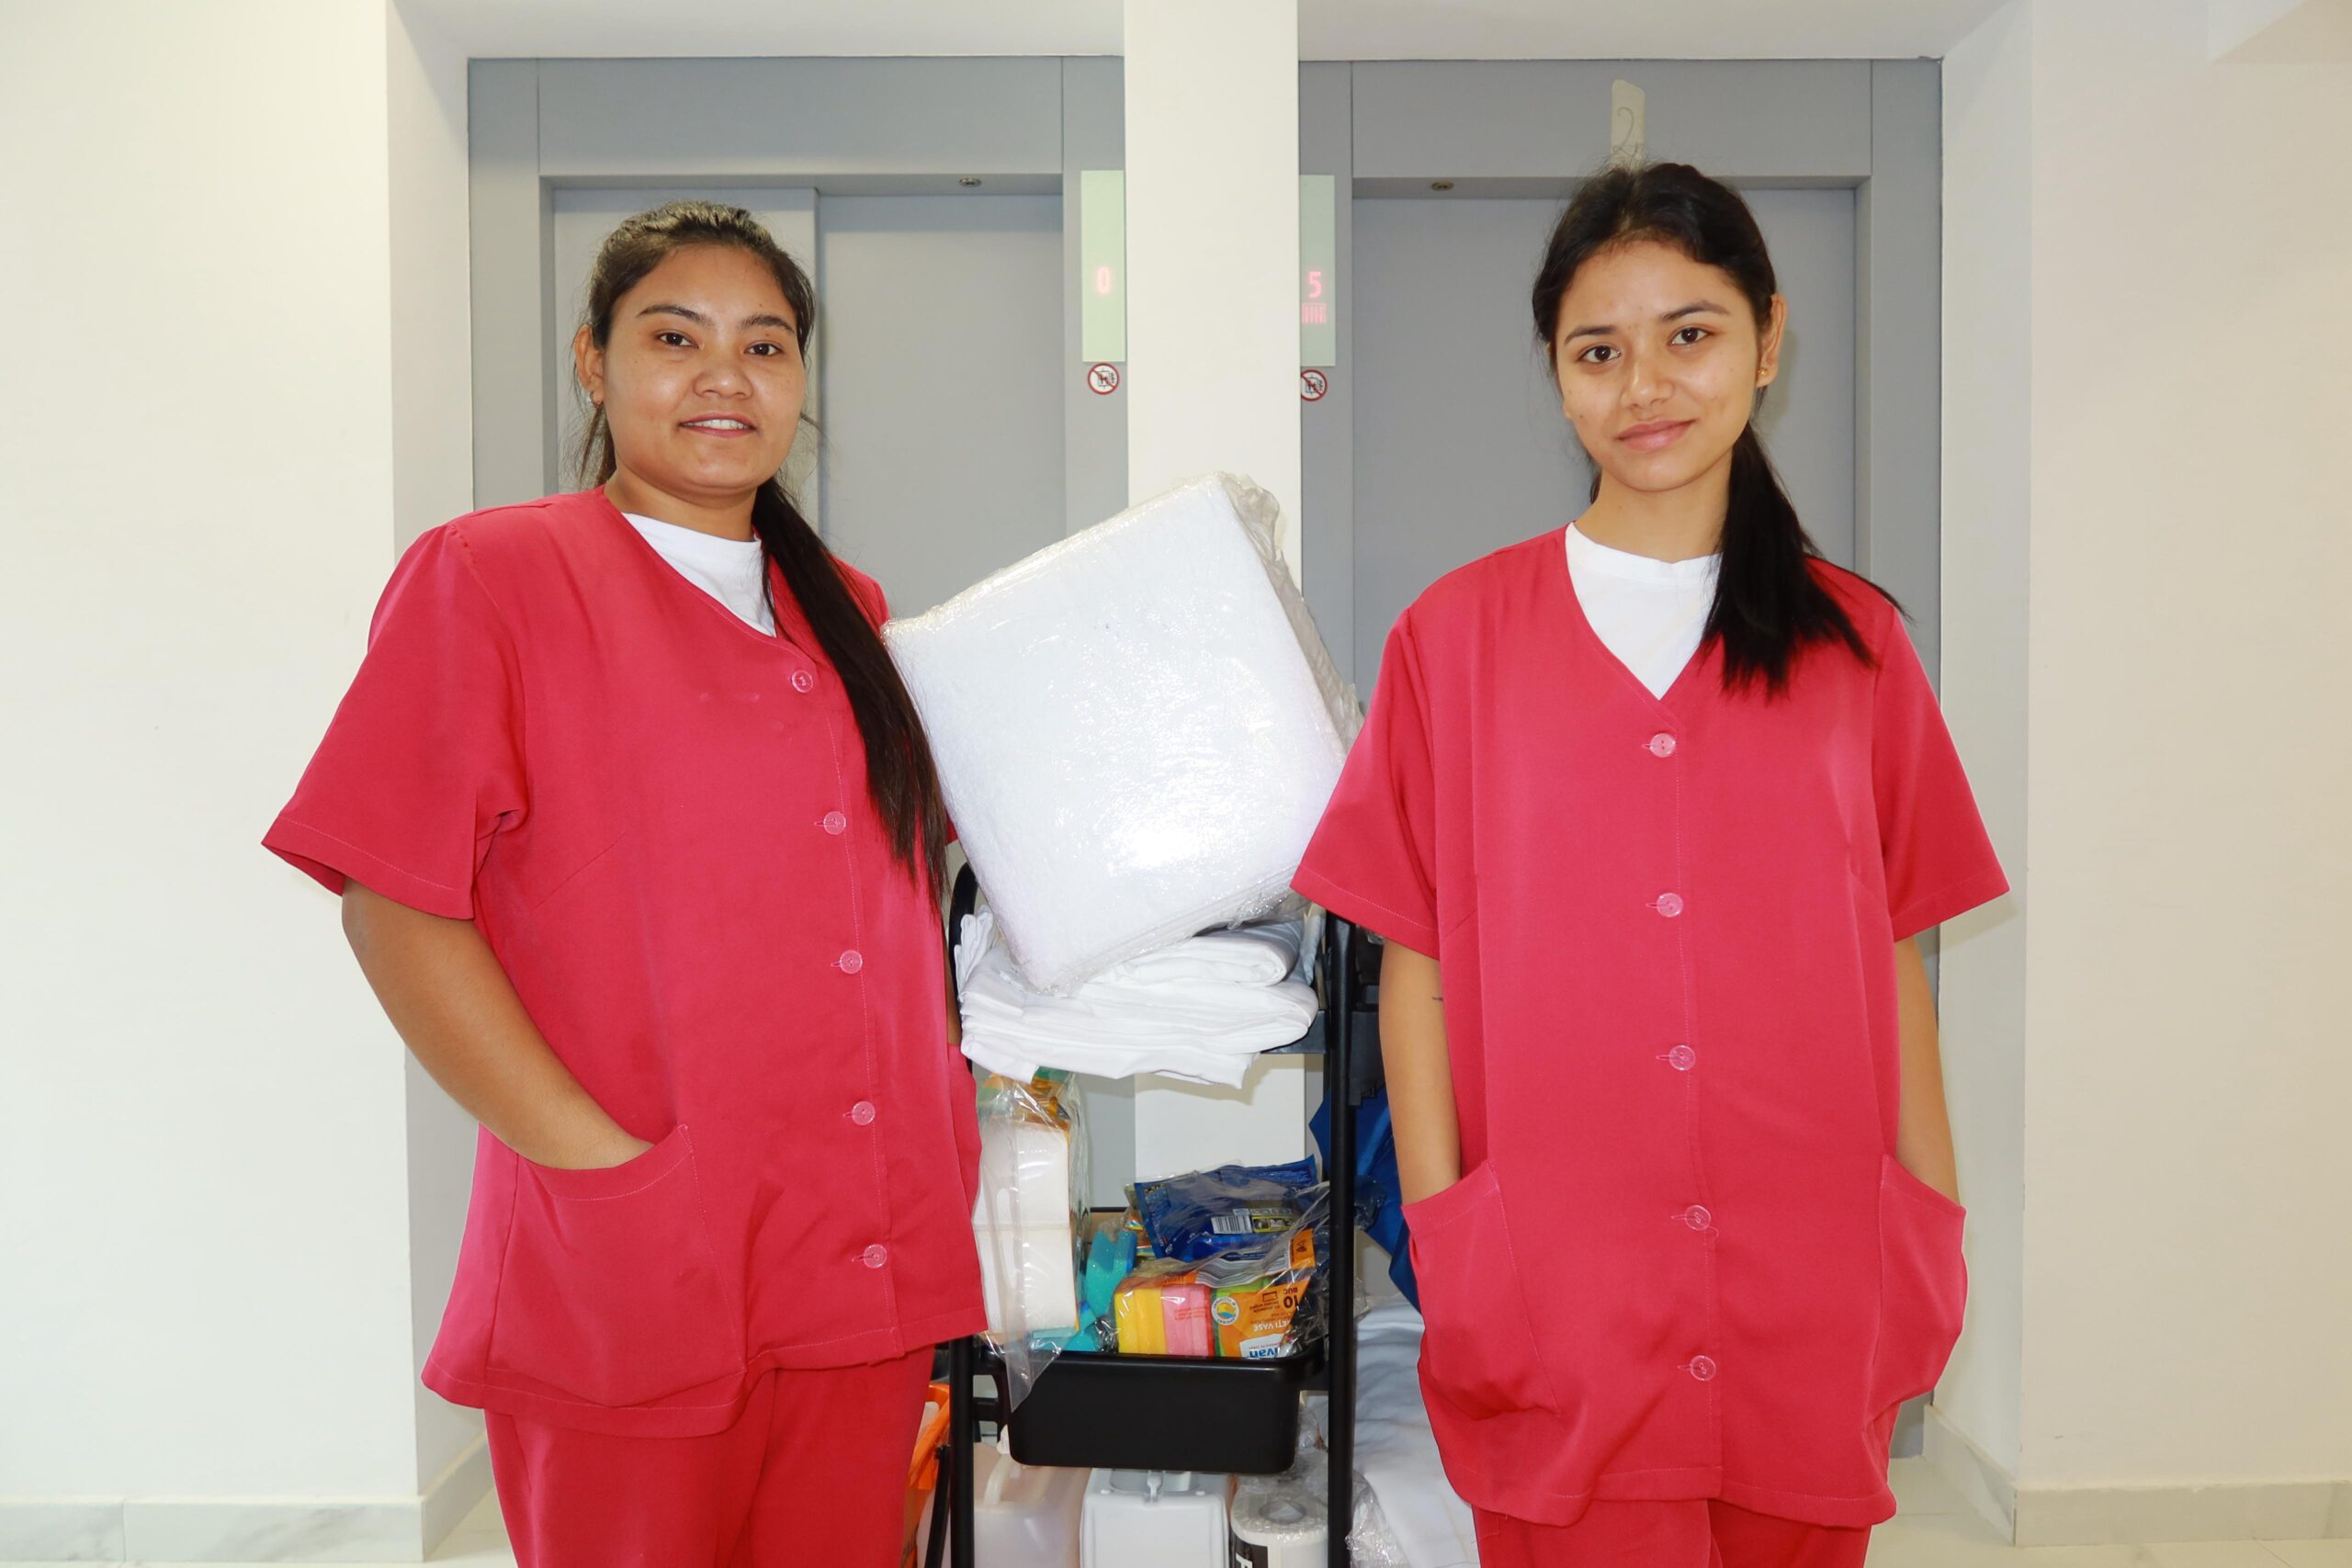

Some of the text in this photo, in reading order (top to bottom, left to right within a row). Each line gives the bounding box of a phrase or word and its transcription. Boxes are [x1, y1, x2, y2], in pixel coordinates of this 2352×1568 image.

[1096, 266, 1112, 294] 0
[1308, 271, 1322, 299] 5
[1283, 1294, 1299, 1308] 10
[1253, 1323, 1273, 1332] VASE
